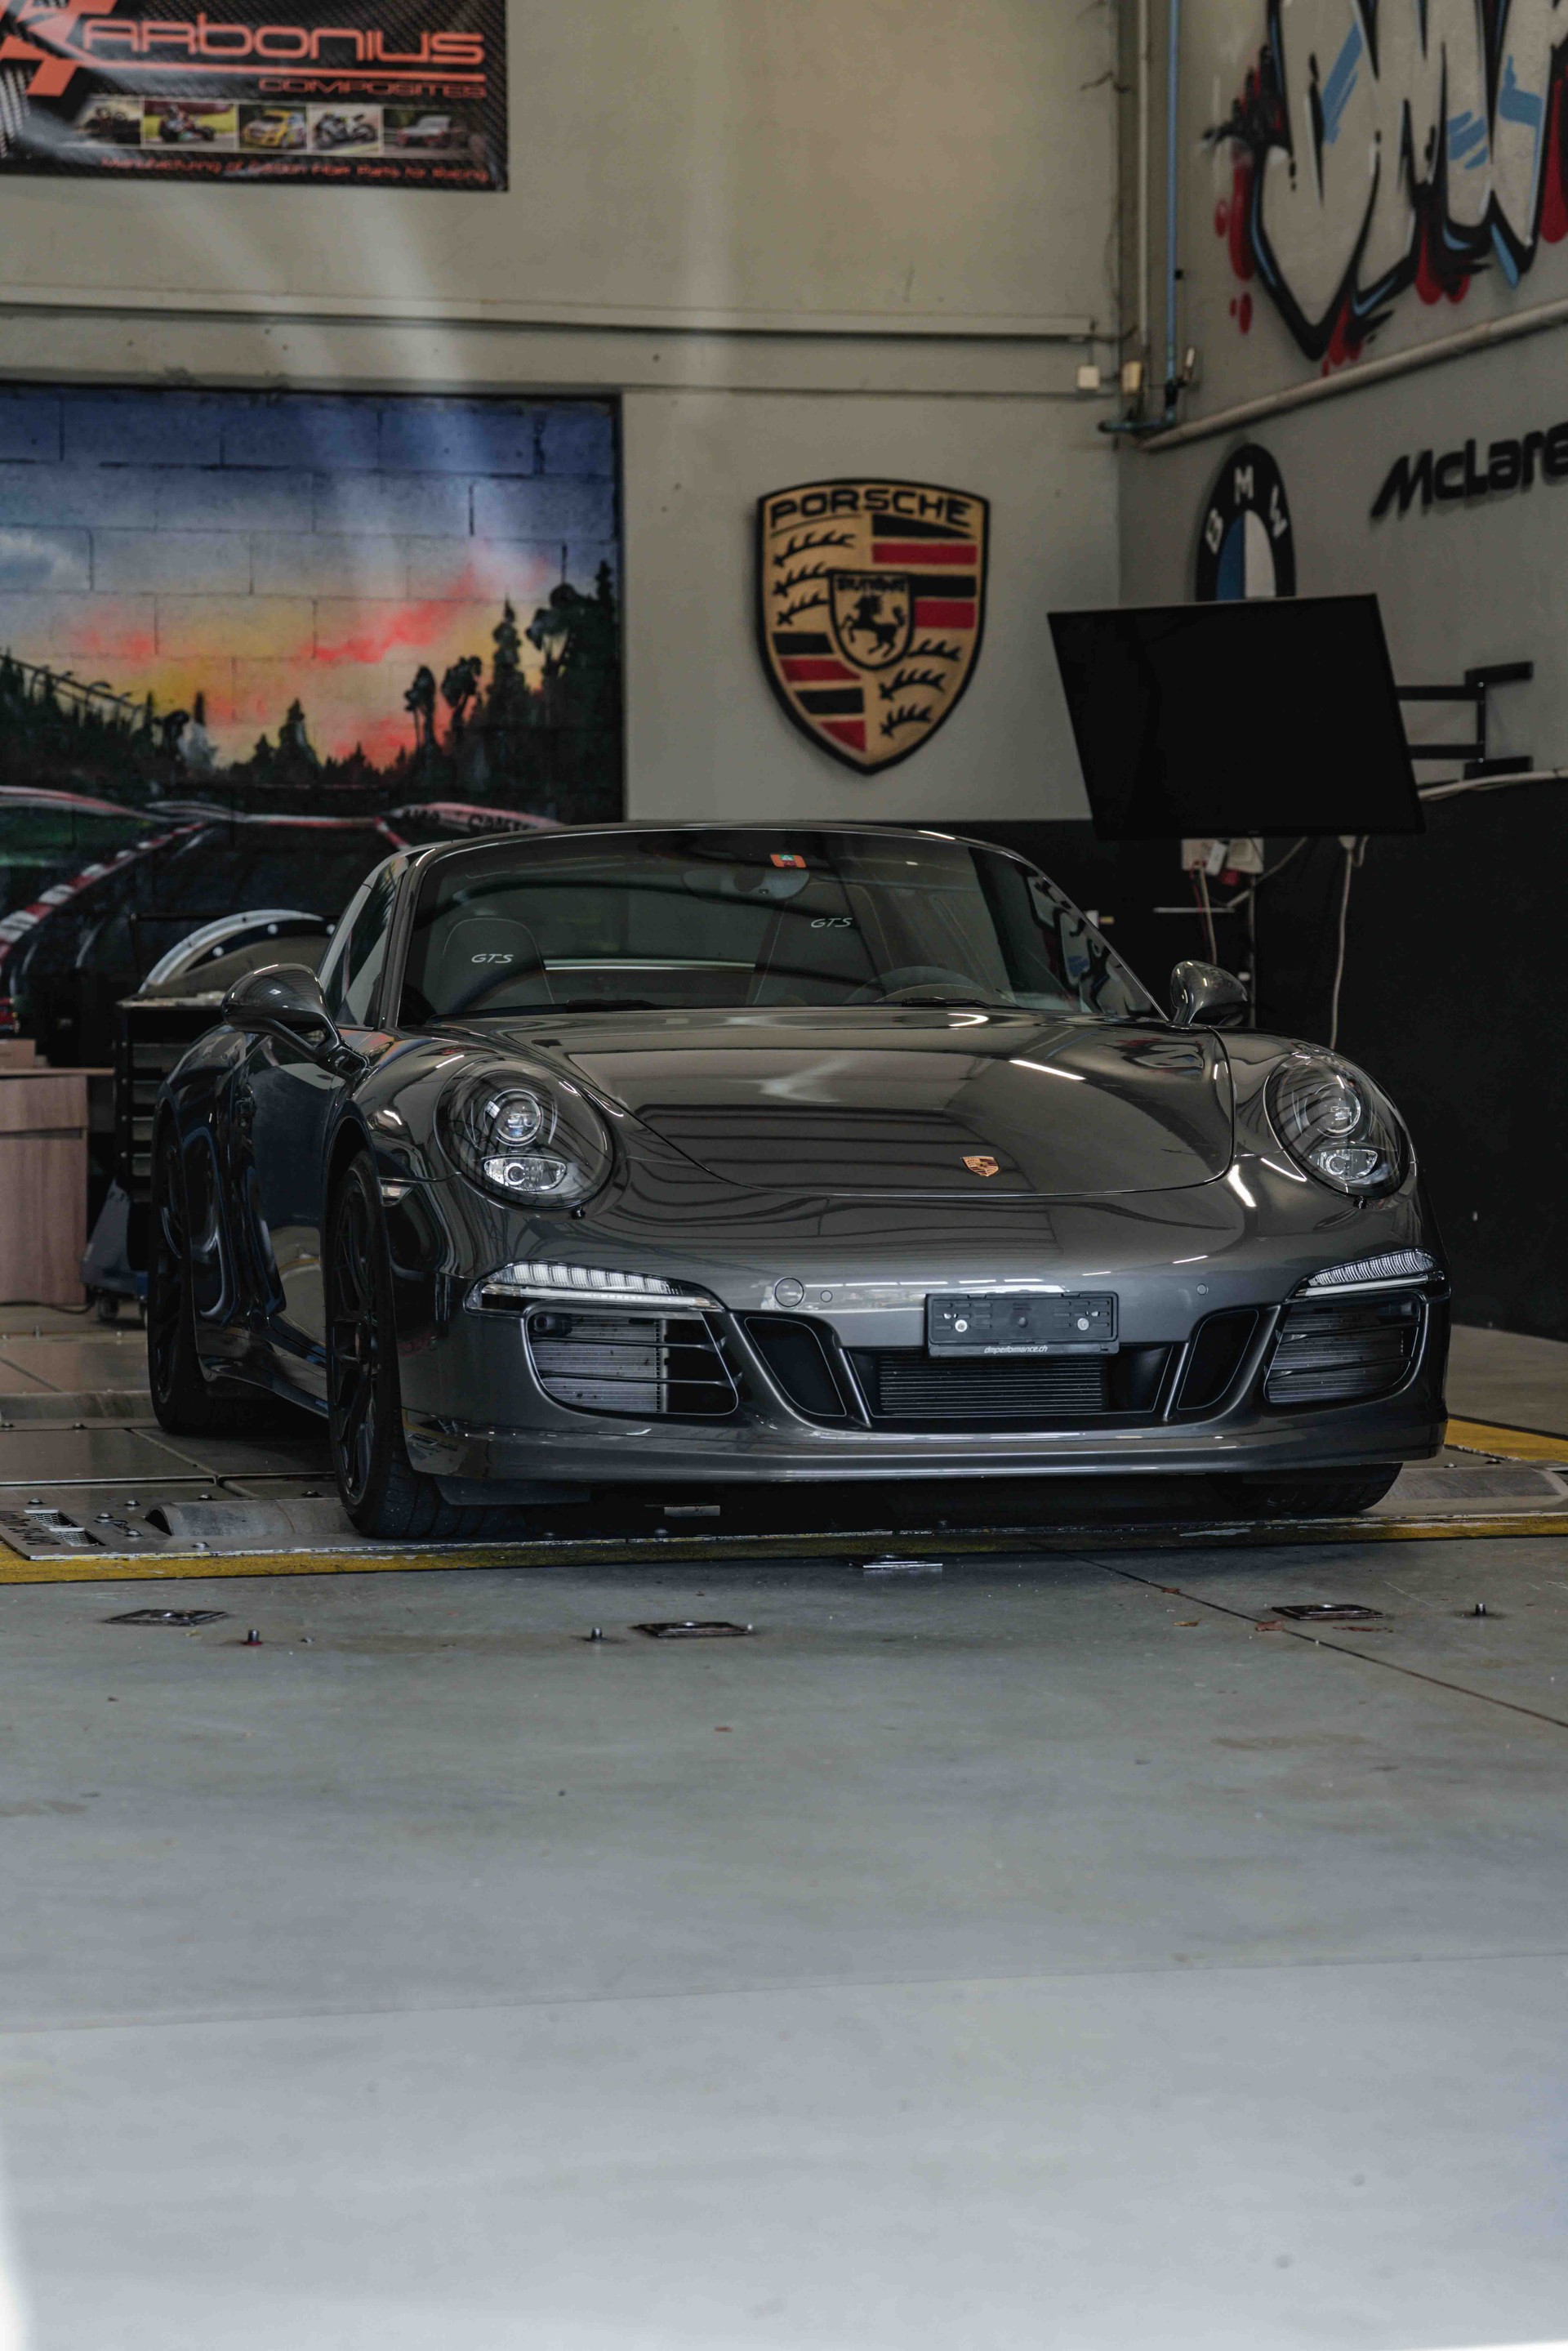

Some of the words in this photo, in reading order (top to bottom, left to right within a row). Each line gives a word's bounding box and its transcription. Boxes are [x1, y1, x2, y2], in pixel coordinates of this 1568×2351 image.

[258, 78, 488, 99] COMPOSITES
[770, 488, 972, 528] PORSCHE
[810, 917, 853, 928] GTS
[471, 953, 514, 964] GTS
